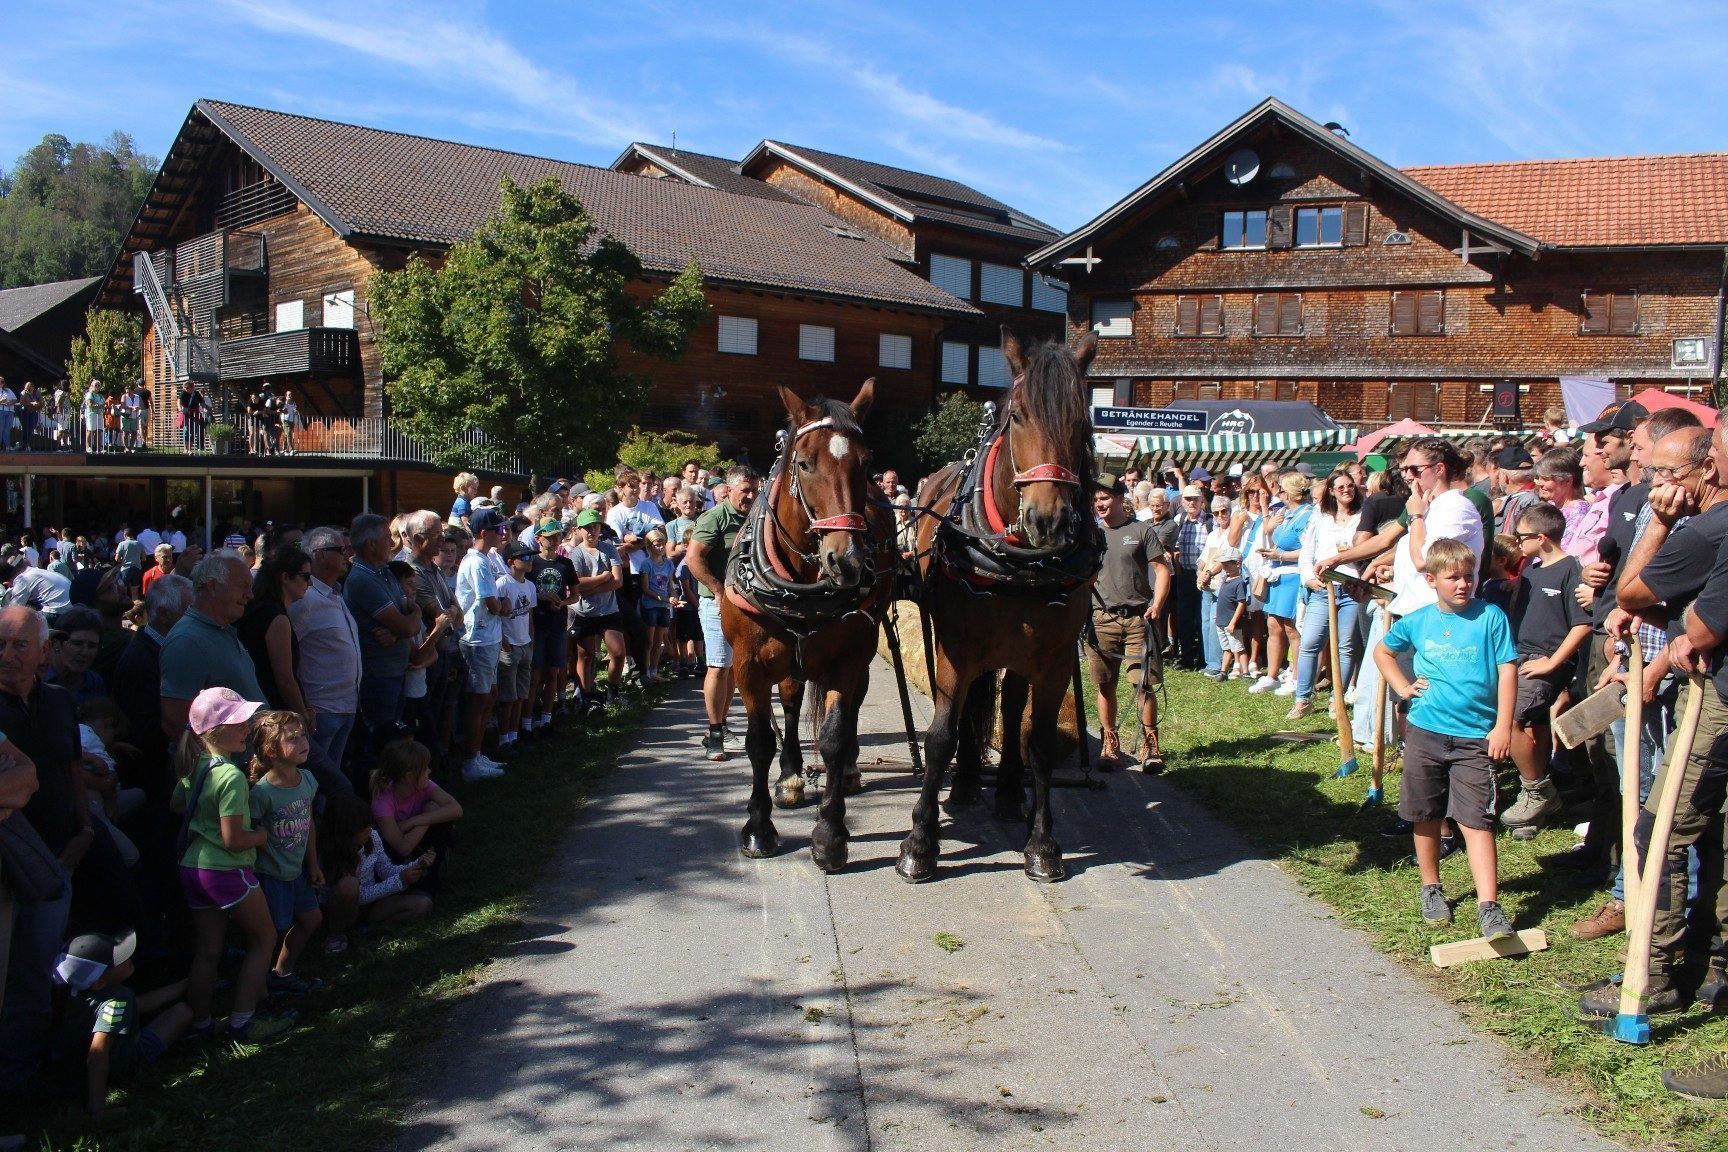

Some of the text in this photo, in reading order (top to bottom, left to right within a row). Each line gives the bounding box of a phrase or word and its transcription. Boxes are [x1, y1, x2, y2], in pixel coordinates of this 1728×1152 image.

[1101, 410, 1200, 422] GETRÄNKEHANDEL
[1599, 405, 1620, 420] STIHL
[1126, 419, 1153, 427] Egender
[1159, 420, 1183, 428] Reuthe
